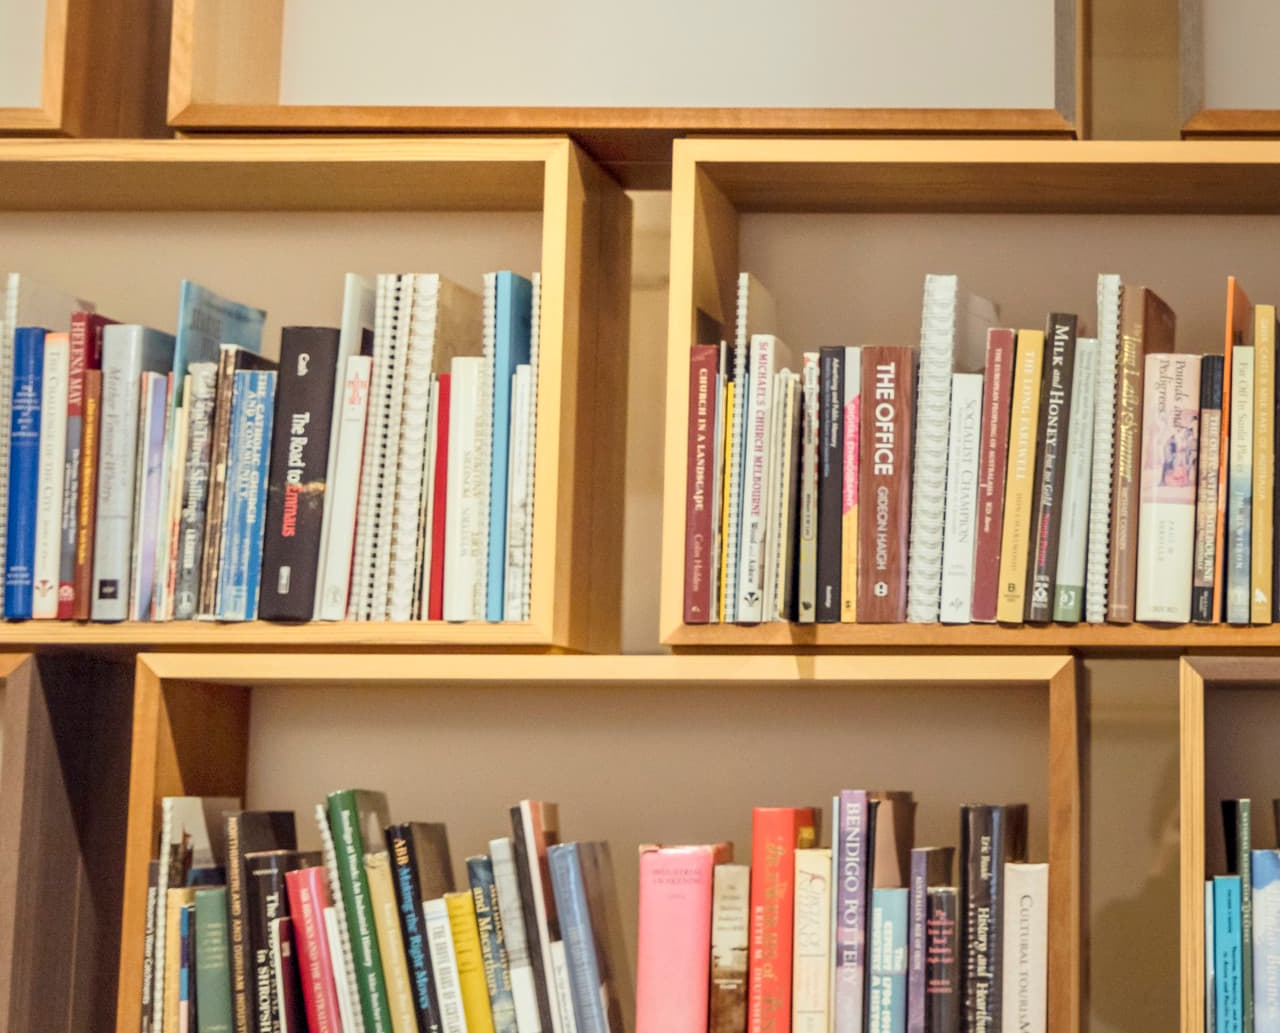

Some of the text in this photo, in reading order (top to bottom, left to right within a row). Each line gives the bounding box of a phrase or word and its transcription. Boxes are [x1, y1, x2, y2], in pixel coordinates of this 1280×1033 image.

[69, 321, 86, 405] HELENA MAY
[830, 358, 840, 390] Advertising
[1045, 324, 1071, 447] MILK and HONEY
[1154, 359, 1171, 414] Pedigrees
[1173, 359, 1188, 429] Pounds and
[246, 391, 258, 417] AND
[751, 351, 769, 517] MICHAEL'S CHURCH MELBOURNE
[829, 423, 838, 448] Memory
[846, 404, 855, 439] DIGITAL
[874, 361, 896, 476] THE OFFICE
[1015, 351, 1036, 481] THE LONG FAREWELL
[1207, 414, 1218, 438] THE
[246, 374, 268, 524] THE CATHOLIC CHURCH
[281, 411, 311, 537] The Road to Emmaus
[694, 368, 709, 512] CHURCH IN A LANDSCAPE
[958, 400, 978, 545] SOCIALIST CHAMPION
[691, 533, 704, 593] Colin Holden
[876, 486, 890, 570] GIDEON HAIGH
[1202, 512, 1215, 582] MELBOURNE
[981, 835, 992, 854] Eric
[228, 816, 245, 990] NORTHUMBERLAND AND DURHAM
[265, 892, 279, 918] The
[341, 809, 373, 967] Bendigo An Industrial History
[844, 802, 861, 985] BENDIGO POTTERY
[142, 886, 157, 1004] Melbourne's Water Catchments
[256, 949, 269, 964] in
[307, 940, 318, 961] AND
[394, 838, 430, 1010] ABB Making the Right Moves
[474, 887, 499, 996] and Macarthurs
[754, 905, 764, 945] KEITH
[883, 921, 894, 970] CEMENT
[973, 907, 993, 978] History and
[1018, 894, 1034, 966] CULTURAL
[367, 972, 382, 1021] Mike Butcher
[871, 976, 882, 987] A
